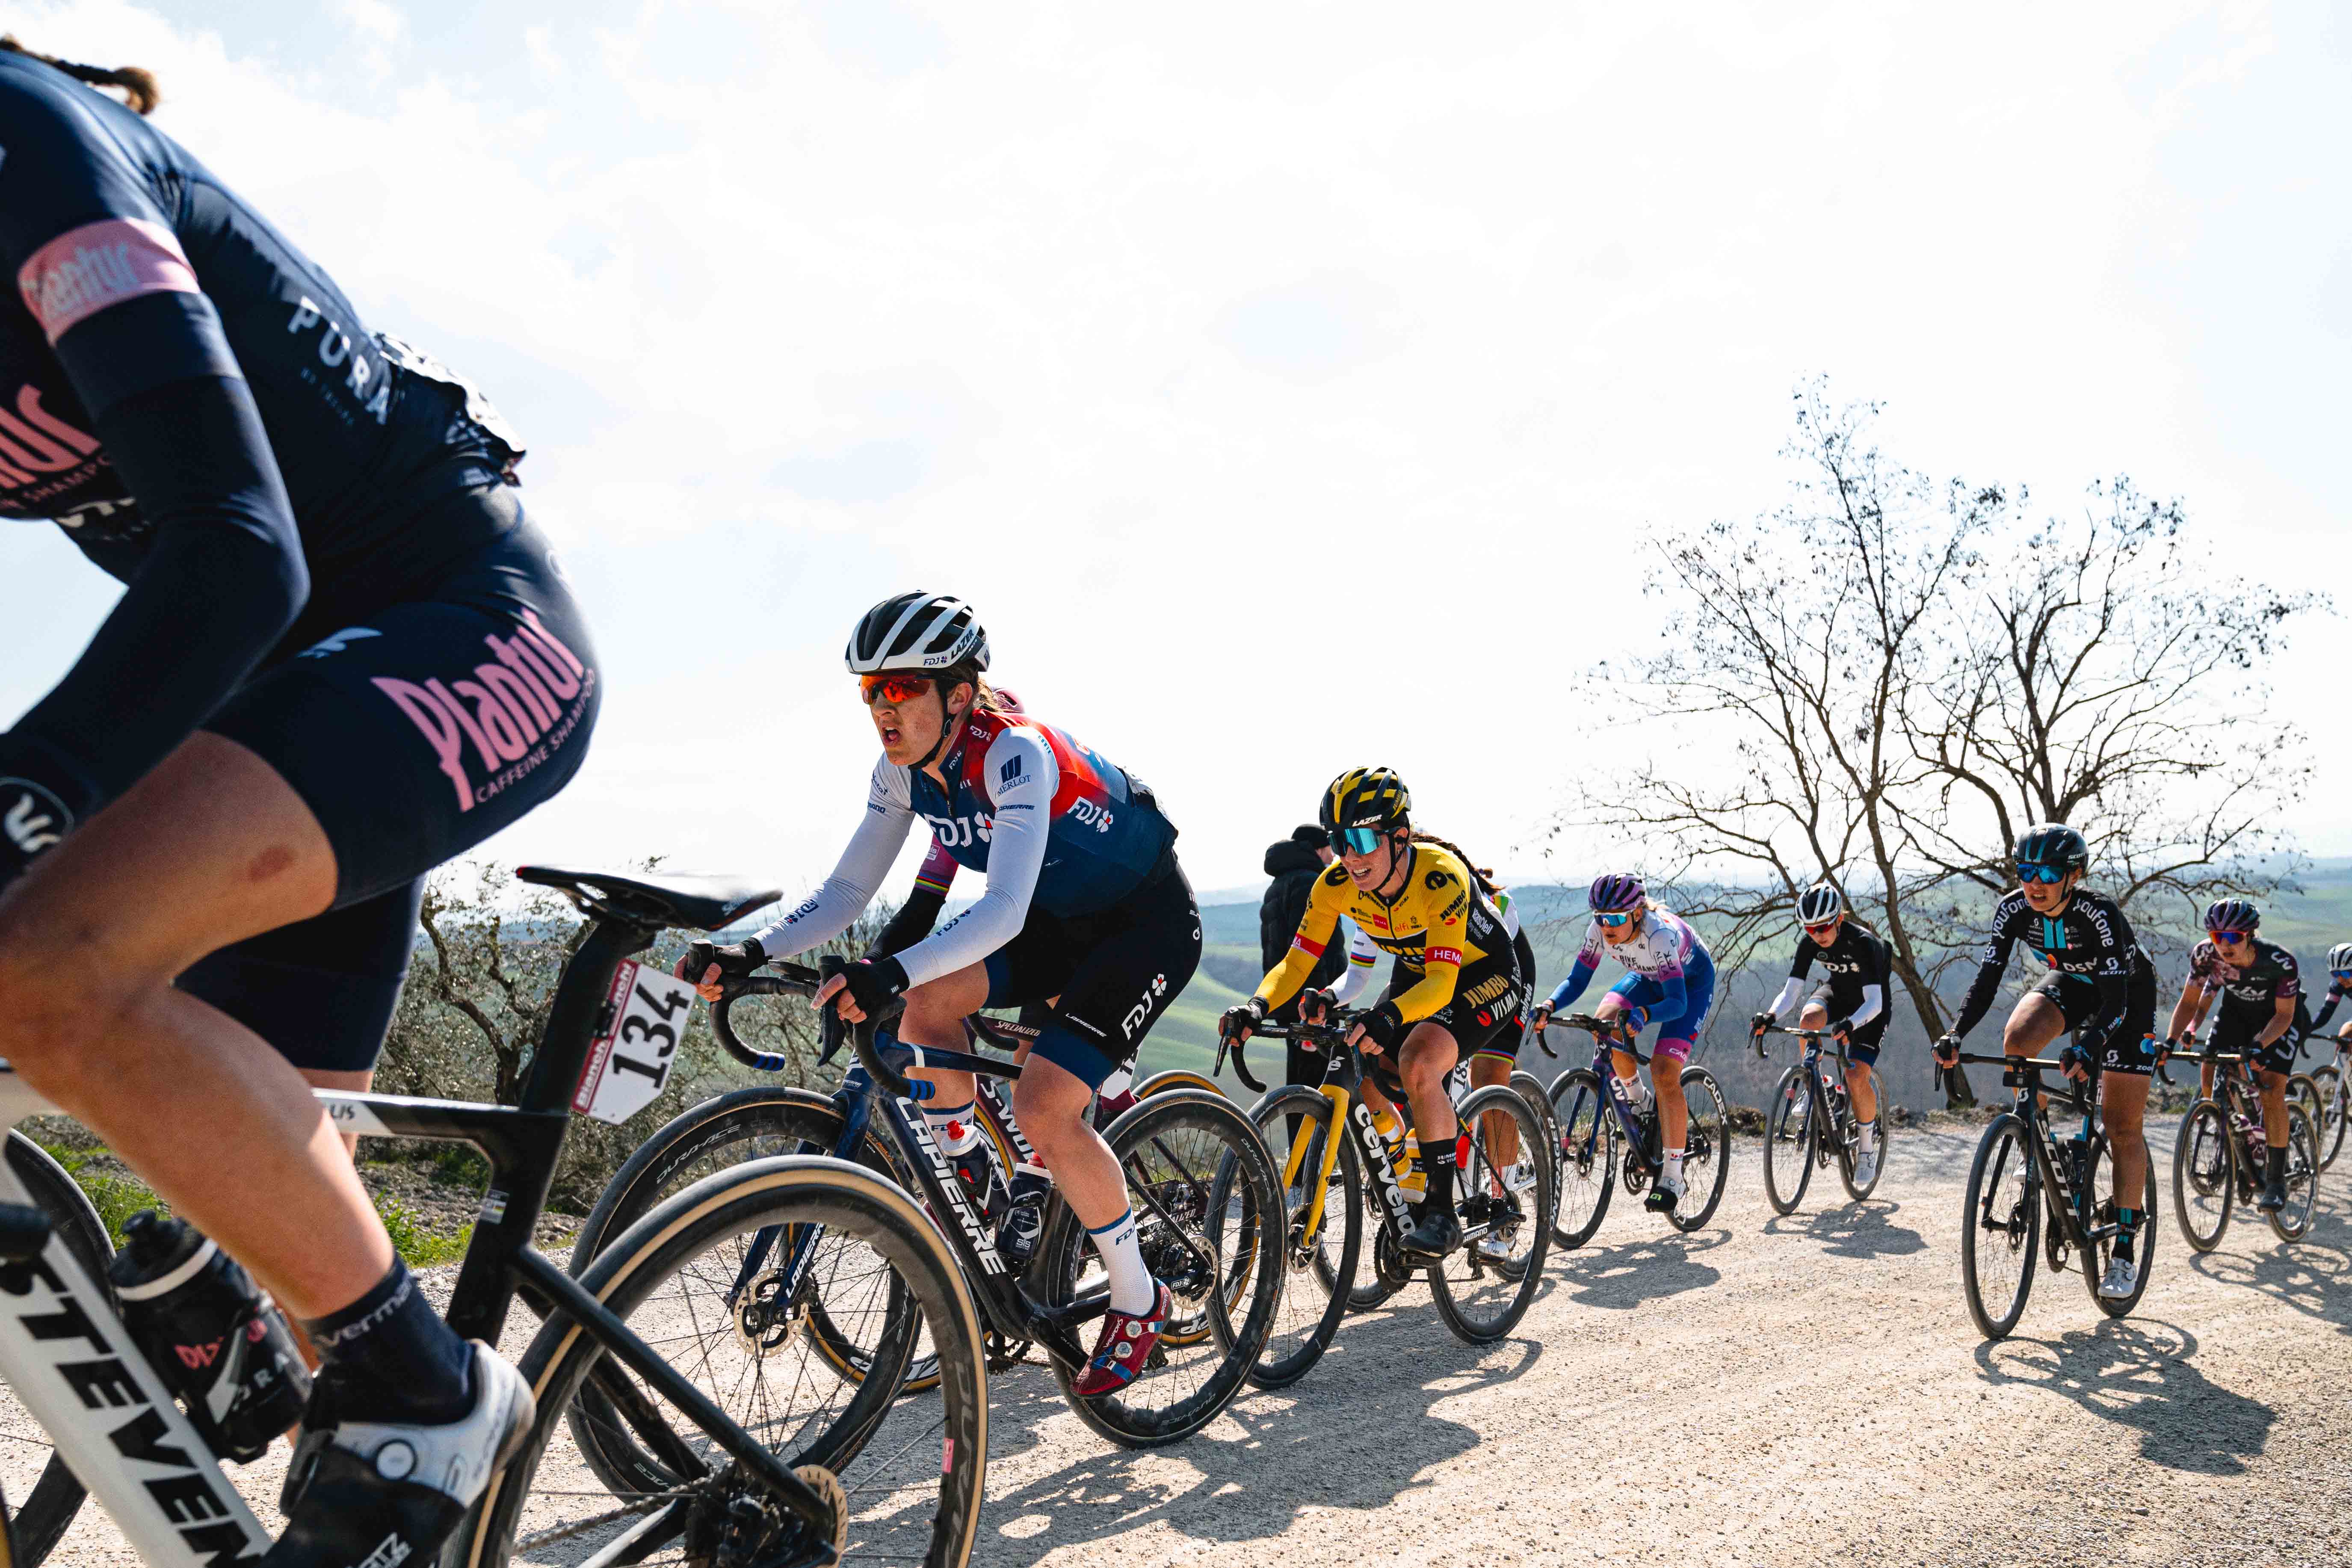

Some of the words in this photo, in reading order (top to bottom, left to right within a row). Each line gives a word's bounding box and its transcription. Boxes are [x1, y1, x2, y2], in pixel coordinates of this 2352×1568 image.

[924, 657, 940, 666] FDJ
[951, 629, 974, 660] LAZER
[370, 606, 584, 813] Plantur
[475, 745, 549, 803] CAFFEINE
[997, 775, 1032, 797] MERLOT
[1067, 795, 1101, 825] FDJ
[1352, 814, 1382, 827] LAZER
[1992, 898, 2030, 940] youfone
[2072, 898, 2114, 948] youfone
[2062, 956, 2098, 973] DSM
[1462, 974, 1509, 1009] JUMBO
[612, 982, 690, 1090] 134
[994, 1020, 1041, 1037] SPECIALIZED
[1065, 1012, 1107, 1037] LAPIERRE
[1121, 990, 1153, 1041] FDJ
[1703, 1075, 1728, 1125] CADEX
[656, 1124, 741, 1184] DURA-ACE
[1605, 1106, 1617, 1183] CADEX
[896, 1096, 1007, 1276] LAPIERRE
[1549, 1116, 1559, 1231] ONTRAGER
[2036, 1119, 2080, 1222] SCOTT
[1160, 1293, 1169, 1316] BROWN
